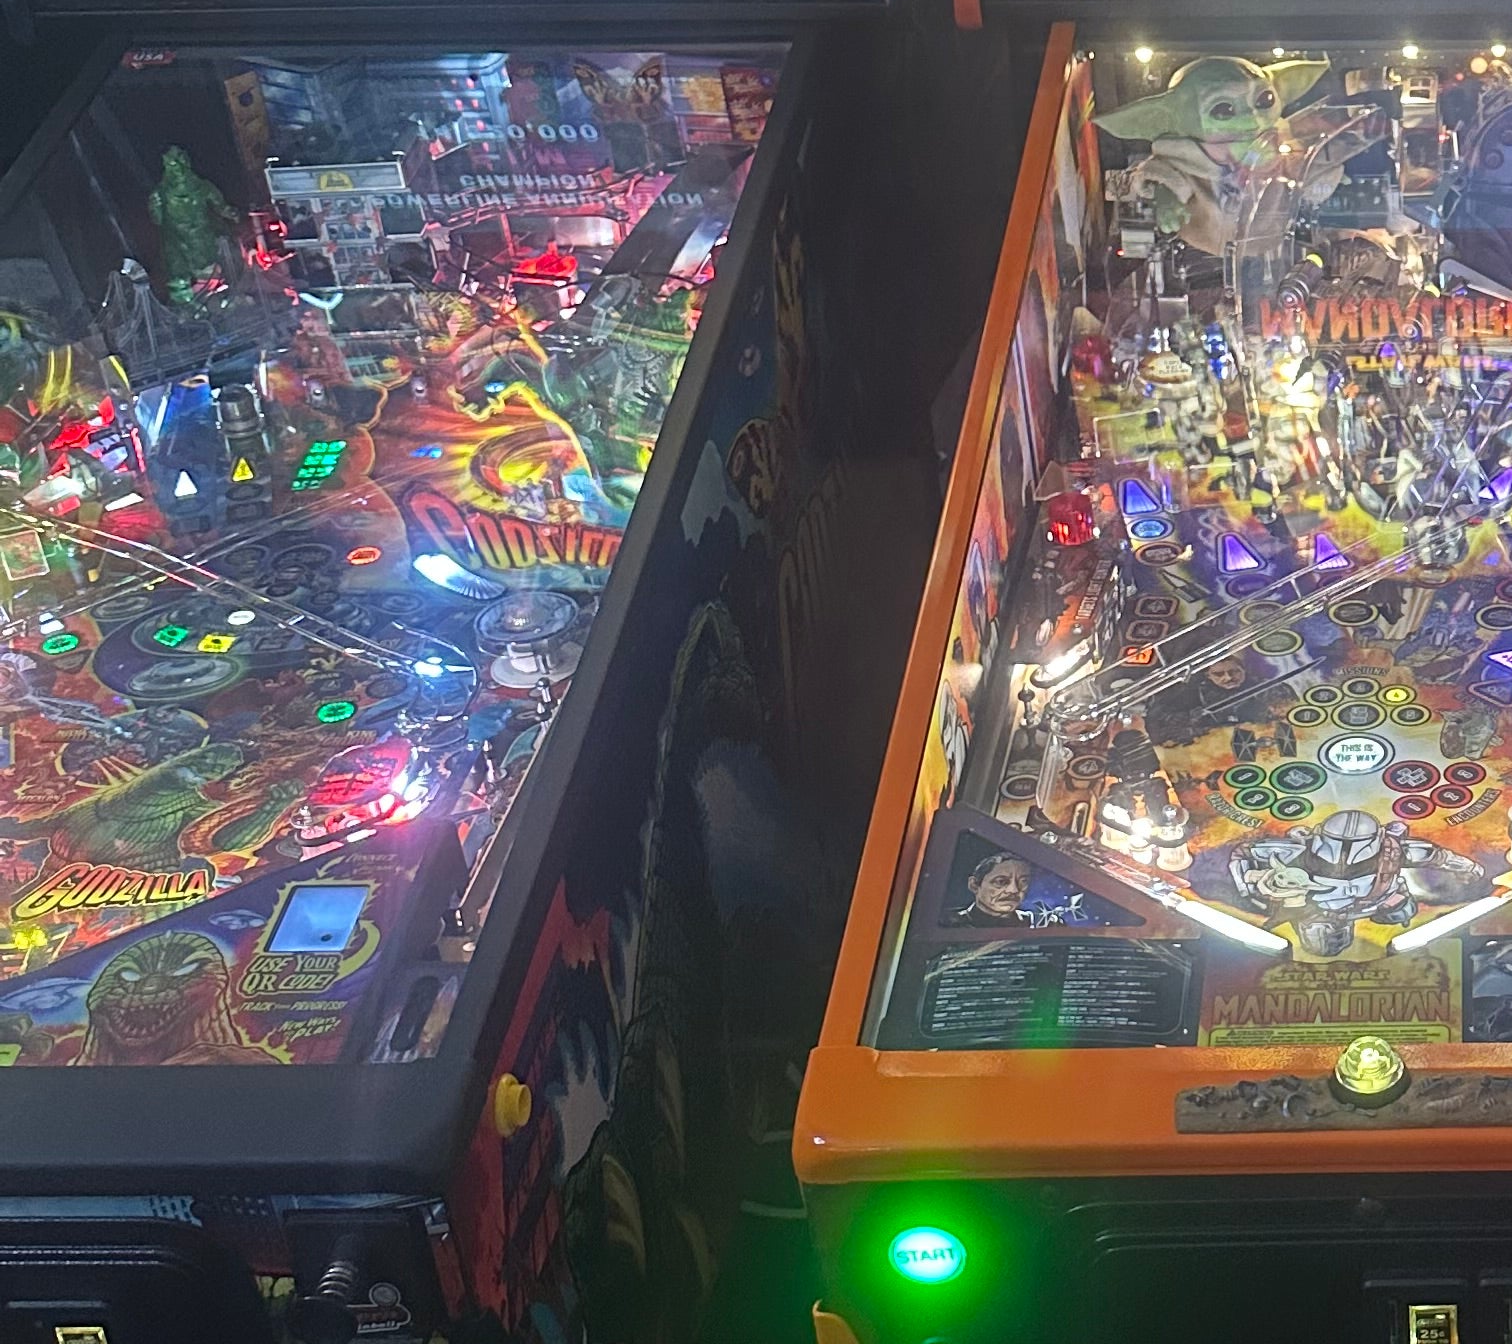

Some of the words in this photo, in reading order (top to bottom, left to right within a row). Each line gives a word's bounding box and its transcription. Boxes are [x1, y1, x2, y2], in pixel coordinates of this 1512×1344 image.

[1340, 744, 1362, 752] THIS
[1363, 744, 1374, 752] IS
[1335, 754, 1352, 762] THE
[1356, 754, 1377, 762] WAY
[15, 864, 208, 921] GODZILLA
[250, 957, 293, 972] USE
[294, 956, 338, 972] YOUR
[242, 973, 277, 993] QR
[279, 974, 334, 990] CODE!
[1275, 969, 1331, 982] STAR
[1332, 969, 1391, 981] WARS
[239, 1002, 273, 1012] TRACK
[1213, 991, 1450, 1025] MANDALORIAN
[896, 1247, 954, 1264] START
